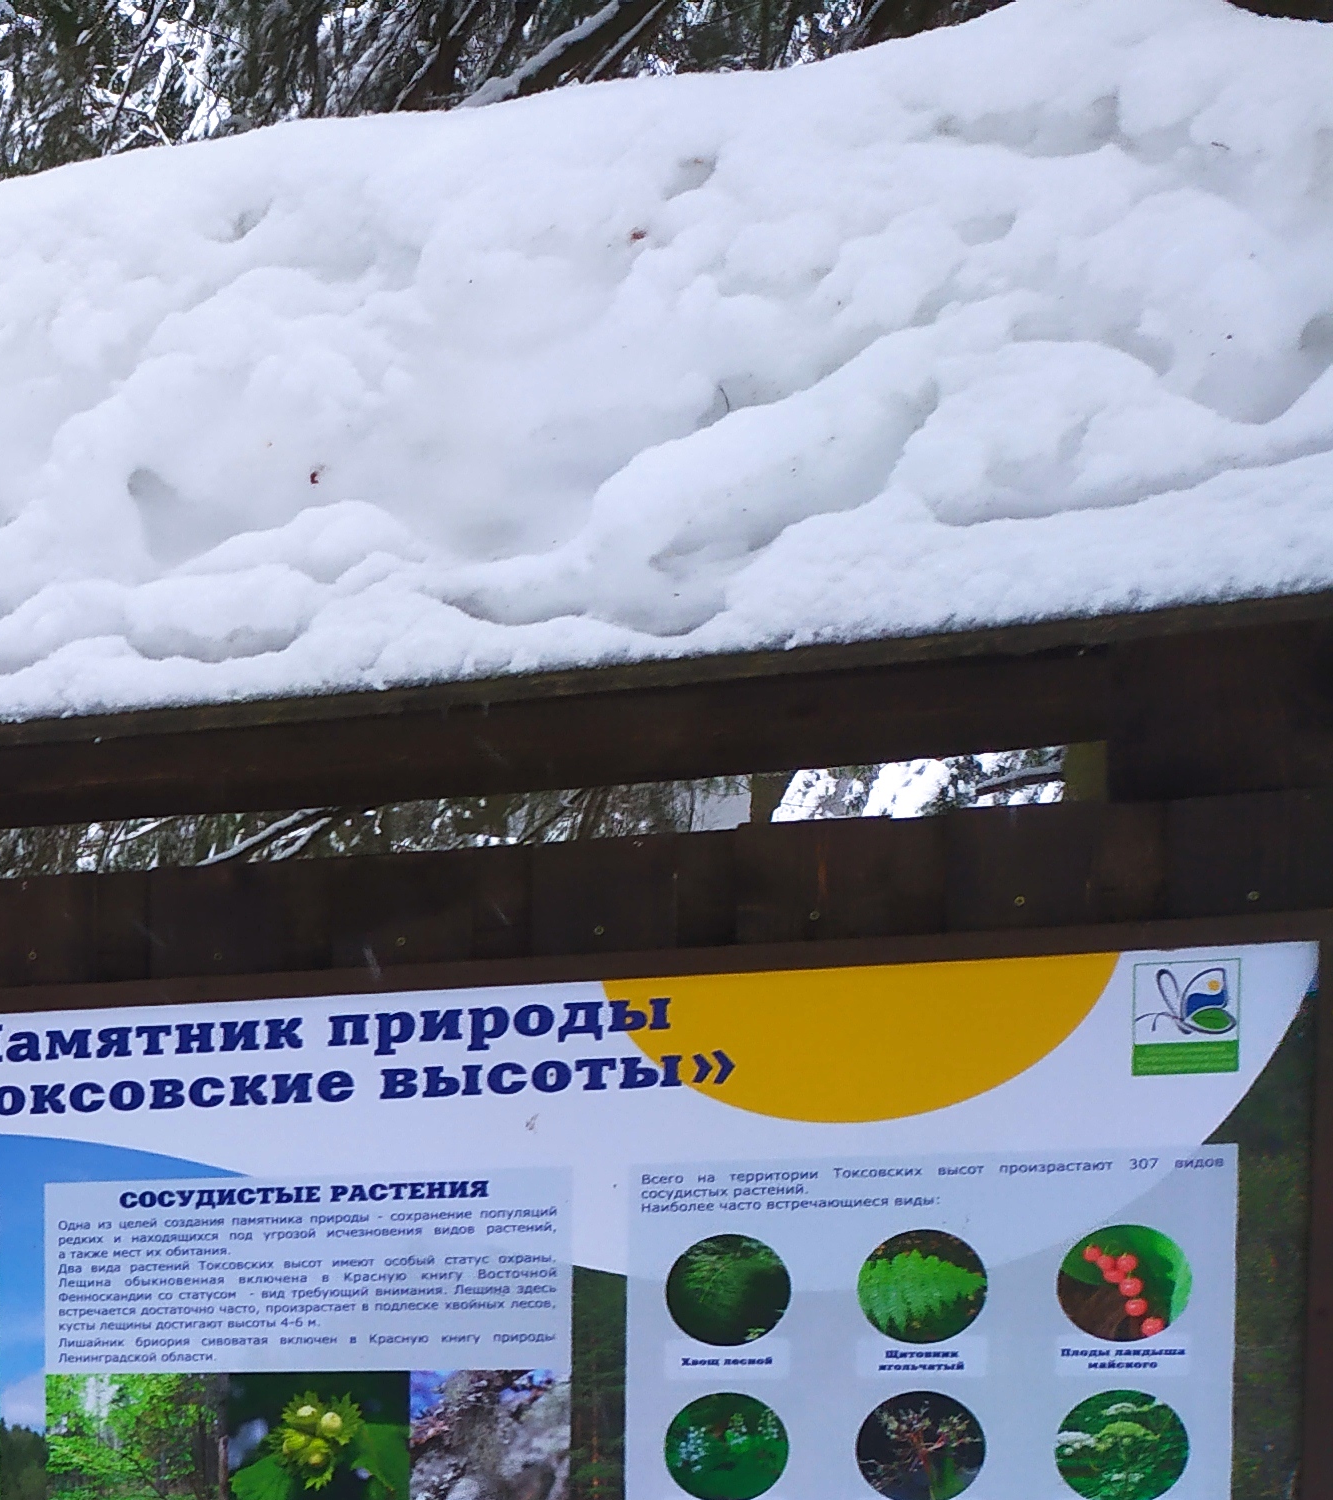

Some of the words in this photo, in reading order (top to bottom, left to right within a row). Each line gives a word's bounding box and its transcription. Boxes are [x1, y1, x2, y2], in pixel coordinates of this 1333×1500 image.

[326, 997, 671, 1055] природы
[378, 1052, 735, 1100] высоты»
[640, 1172, 684, 1185] Всего
[697, 1174, 715, 1183] на
[728, 1170, 818, 1184] территории
[832, 1164, 922, 1179] Токсовских
[937, 1165, 984, 1176] высот
[998, 1161, 1113, 1174] произрастают
[1129, 1157, 1159, 1170] 307
[1174, 1157, 1224, 1169] видов
[119, 1185, 321, 1209] СОСУДИСТЫЕ
[329, 1179, 489, 1202] РАСТЕНИЯ
[640, 1188, 728, 1200] сосудистых
[732, 1183, 809, 1196] растений.
[640, 1200, 715, 1213] Наиболее
[716, 1200, 762, 1211] часто
[765, 1197, 889, 1210] встречающиеся
[893, 1196, 940, 1207] виды:
[57, 1219, 91, 1231] Одна
[97, 1220, 112, 1230] из
[118, 1217, 157, 1229] целей
[163, 1217, 225, 1228] создания
[231, 1215, 303, 1225] памятника
[309, 1213, 370, 1225] природы
[389, 1210, 472, 1221] сохранение
[479, 1205, 557, 1220] популяций
[57, 1262, 82, 1275] Два
[90, 1264, 121, 1274] вида
[129, 1260, 190, 1272] растений
[197, 1259, 274, 1271] Токсовских
[283, 1259, 323, 1269] высот
[331, 1258, 375, 1267] имеют
[383, 1254, 435, 1266] особый
[443, 1255, 490, 1265] статус
[497, 1253, 557, 1264] охраны.
[58, 1276, 111, 1288] Лещина
[124, 1276, 224, 1286] обыкновенная
[238, 1274, 307, 1284] включена
[321, 1274, 329, 1282] в
[343, 1271, 407, 1284] Красную
[420, 1271, 463, 1281] книгу
[477, 1267, 557, 1279] Восточной
[58, 1322, 96, 1332] кусты
[98, 1321, 152, 1330] лещины
[154, 1320, 224, 1330] достигают
[227, 1319, 276, 1328] высоты
[279, 1316, 303, 1327] 4-6
[307, 1319, 321, 1327] м.
